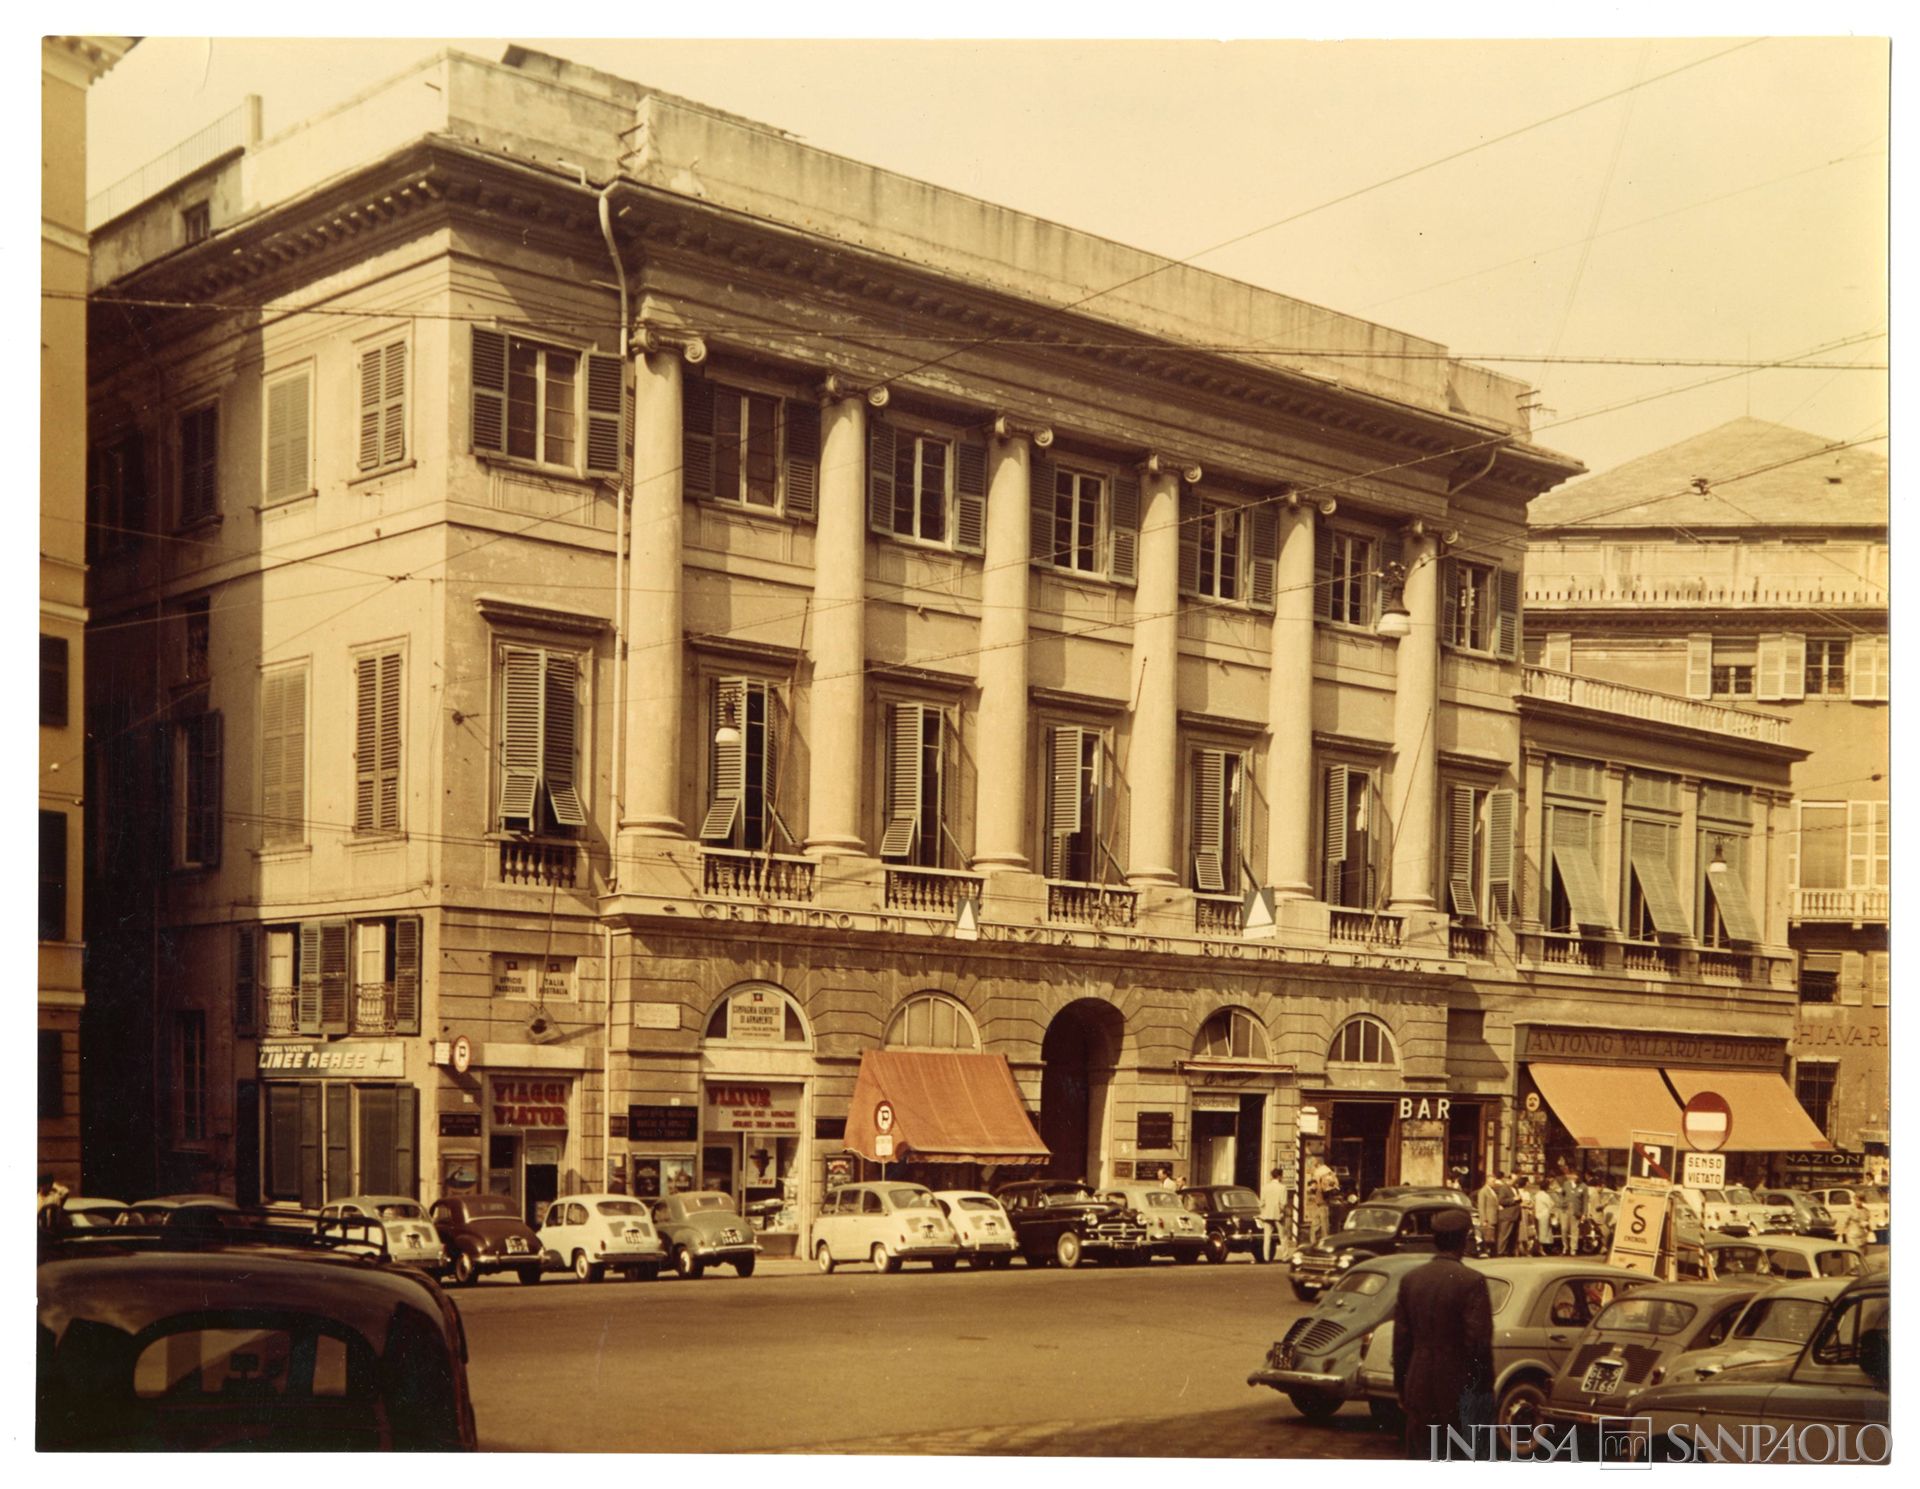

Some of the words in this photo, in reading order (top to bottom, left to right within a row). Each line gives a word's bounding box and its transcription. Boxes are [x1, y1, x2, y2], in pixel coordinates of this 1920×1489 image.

[700, 903, 855, 930] CREDITO
[924, 919, 1077, 947] VNEZIA
[1200, 941, 1244, 959] RIO
[542, 977, 565, 987] TALIA
[1530, 1033, 1612, 1053] ANTONIO
[259, 1053, 303, 1069] LINEE
[307, 1053, 367, 1069] AEREE
[493, 1082, 566, 1103] VIAGGI
[706, 1087, 772, 1107] VIATUR
[493, 1105, 568, 1126] VIATUR
[1400, 1098, 1450, 1119] BAR
[1688, 1156, 1722, 1169] SENSO
[1688, 1171, 1721, 1185] VIETATO
